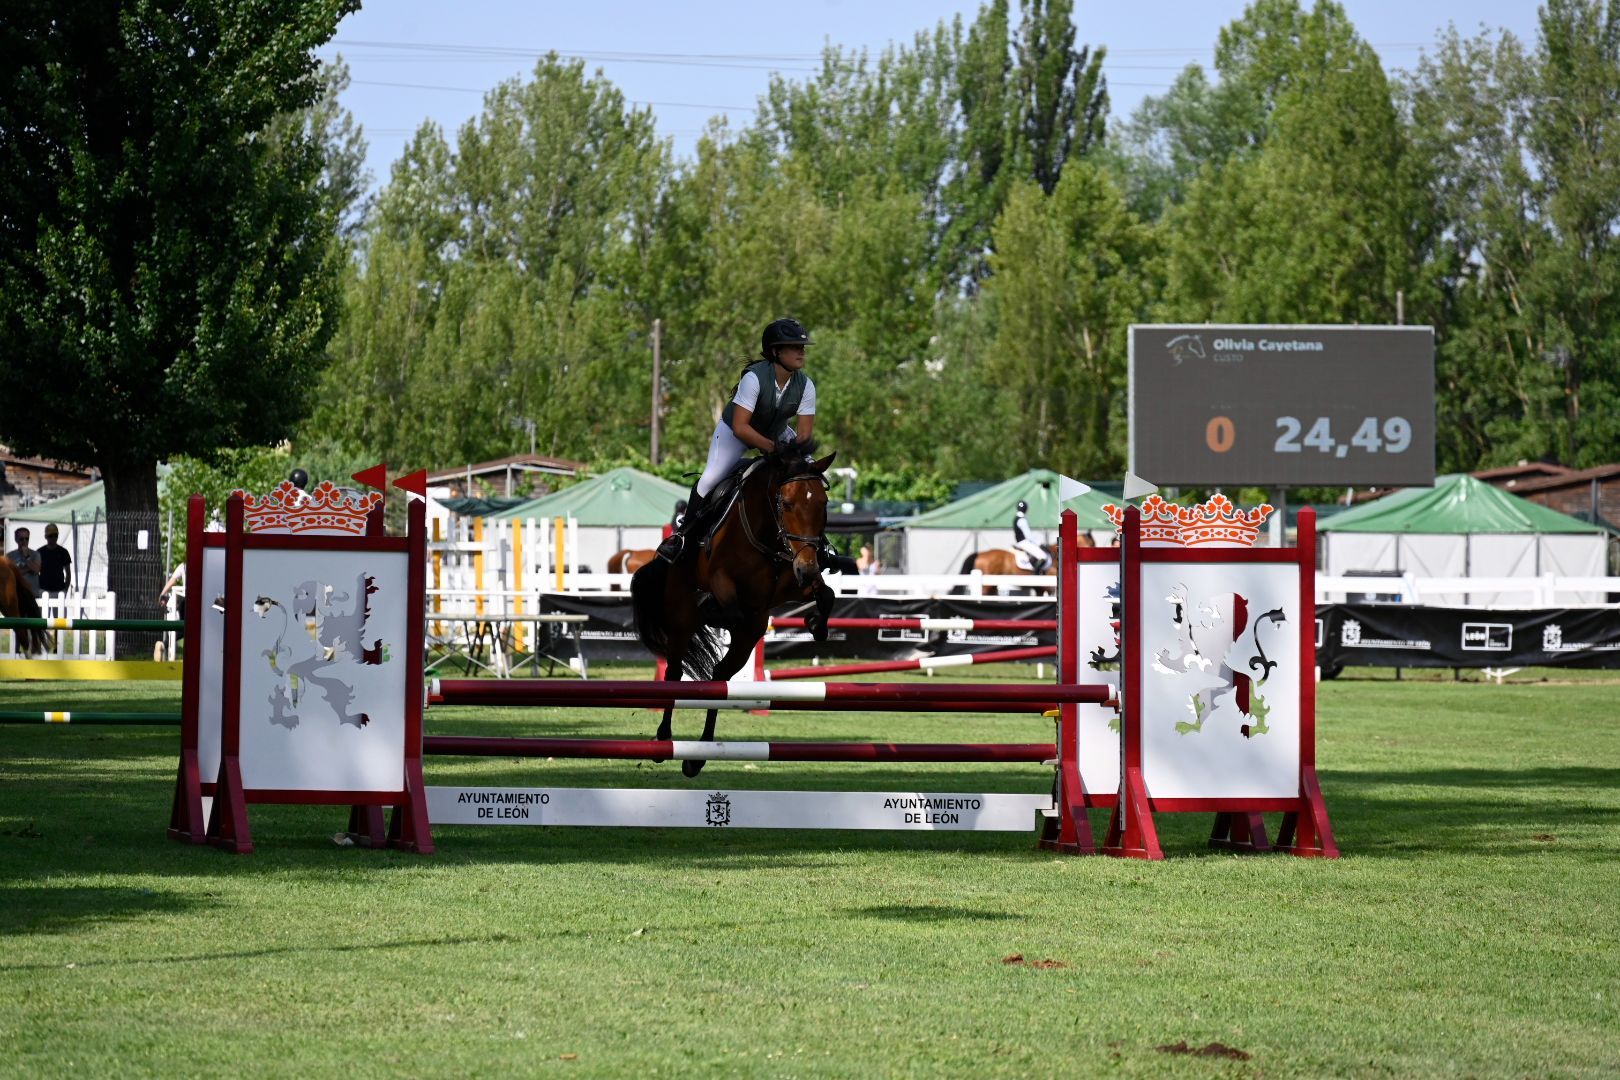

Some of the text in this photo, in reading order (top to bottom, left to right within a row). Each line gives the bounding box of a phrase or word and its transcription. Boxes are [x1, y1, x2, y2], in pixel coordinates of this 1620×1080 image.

[1213, 339, 1323, 352] Olivia Cayetana
[1206, 416, 1412, 458] 0 24,49
[458, 793, 549, 804] AYUNTAMIENTO
[884, 799, 980, 810] AYUNTAMIENTO
[478, 805, 529, 818] DE LEÓN
[905, 811, 959, 824] DE LEÓN
